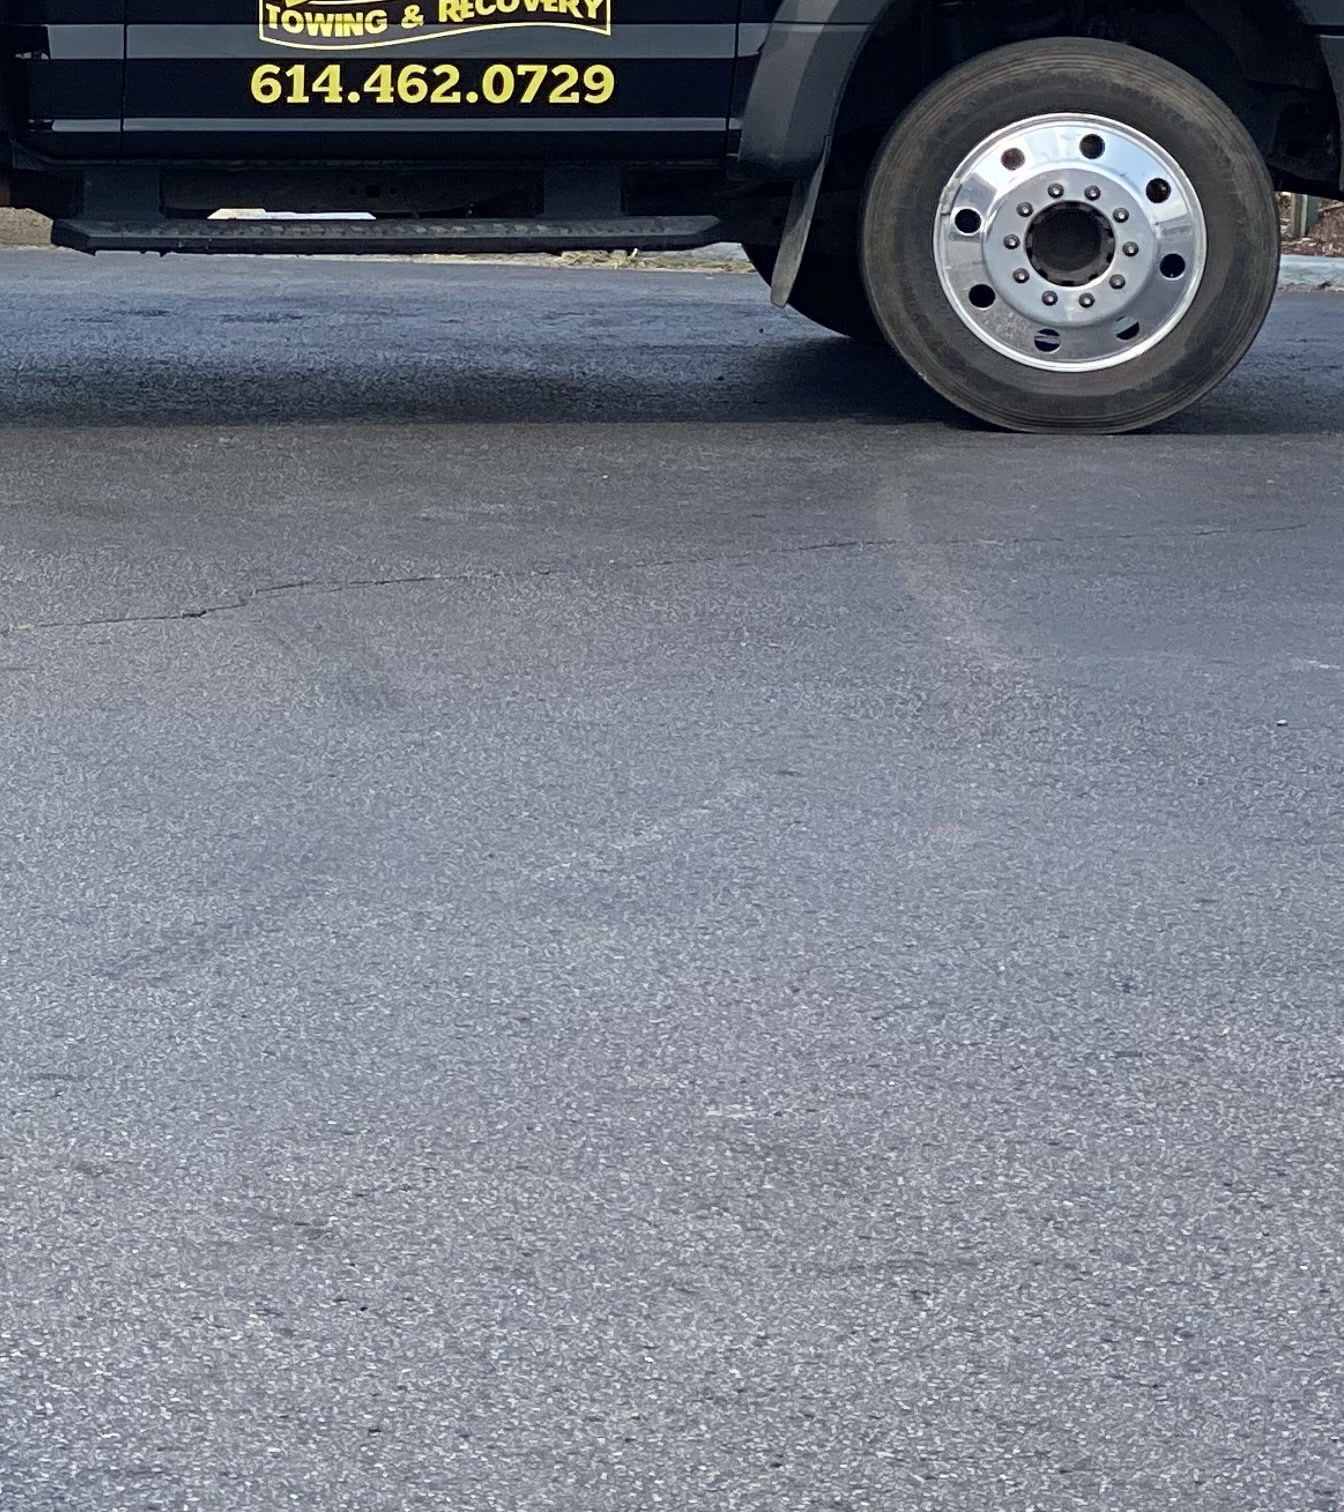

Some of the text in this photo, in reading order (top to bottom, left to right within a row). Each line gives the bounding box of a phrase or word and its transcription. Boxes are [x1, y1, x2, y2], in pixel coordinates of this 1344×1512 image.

[265, 3, 388, 38] TOWING
[401, 4, 424, 29] &
[250, 64, 615, 104] 614.462.0729
